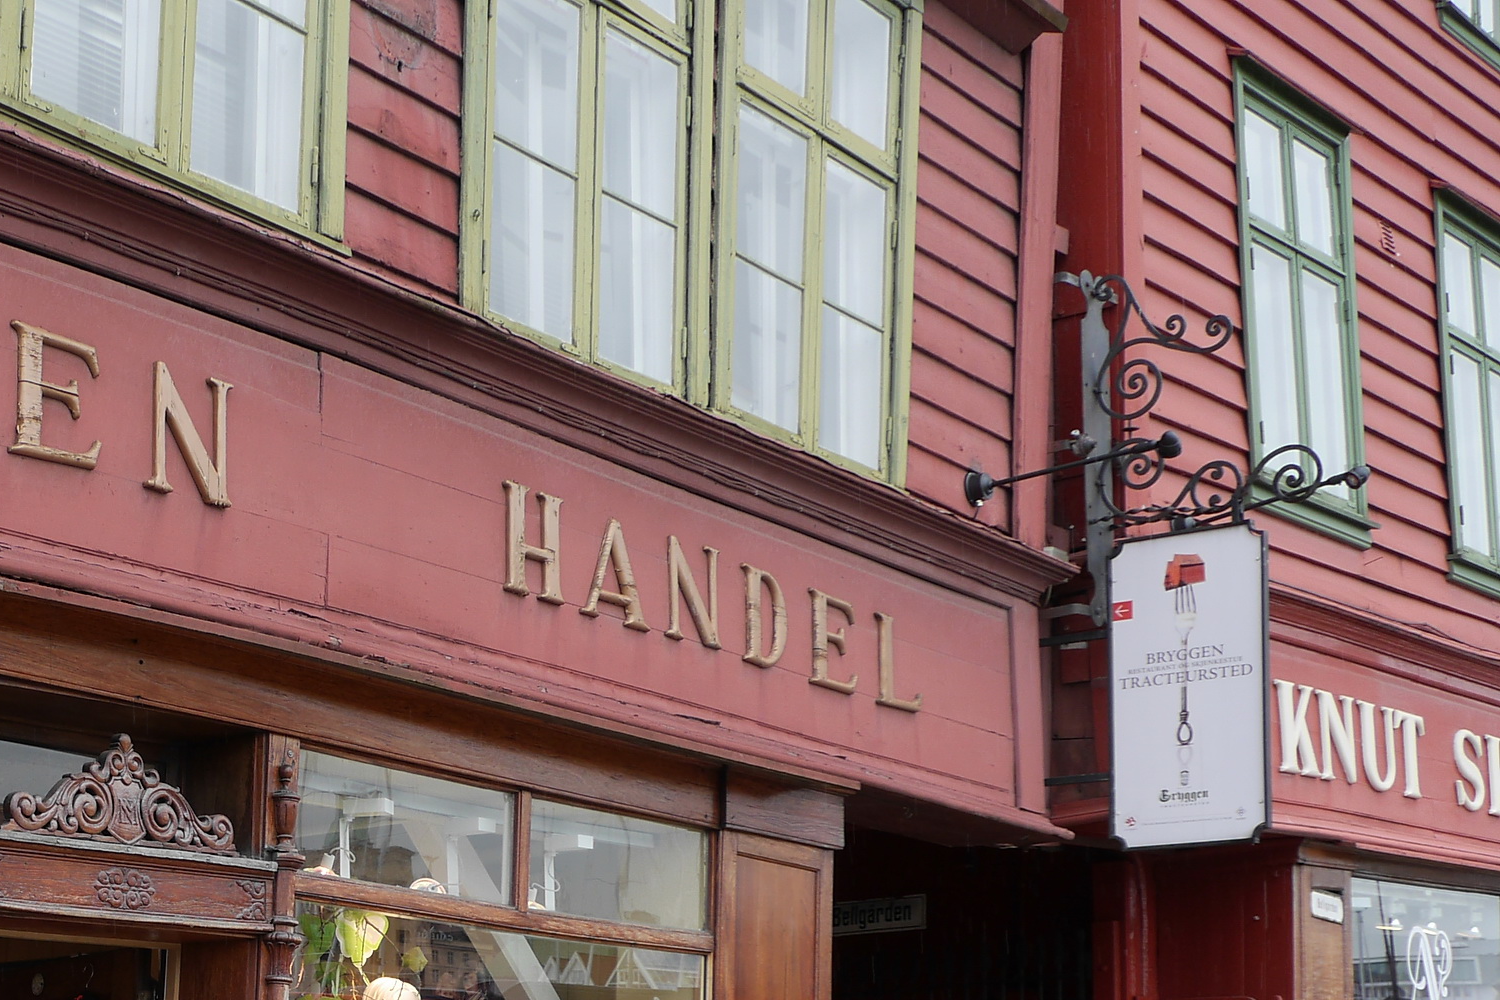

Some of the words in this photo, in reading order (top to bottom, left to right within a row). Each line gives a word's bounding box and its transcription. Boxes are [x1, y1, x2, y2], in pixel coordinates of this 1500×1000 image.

[502, 479, 922, 713] HANDEL
[1119, 663, 1253, 690] TRACTEURSTED
[1146, 644, 1224, 665] BRYGGEN
[1273, 678, 1425, 799] KNUT
